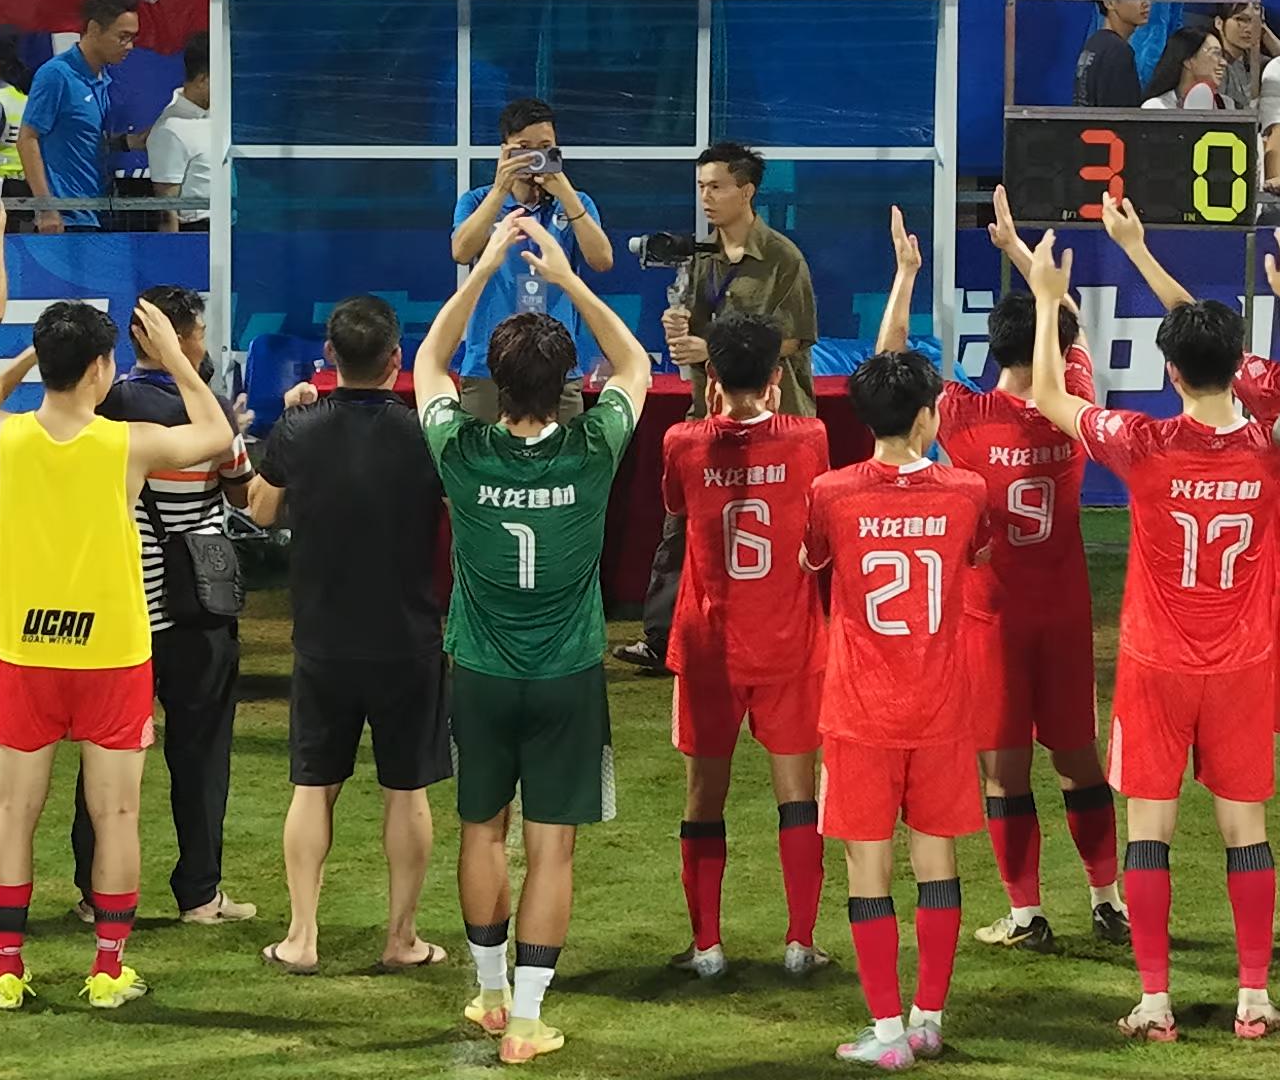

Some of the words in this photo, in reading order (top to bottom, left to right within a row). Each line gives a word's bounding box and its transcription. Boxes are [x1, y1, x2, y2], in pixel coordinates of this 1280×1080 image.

[1079, 129, 1125, 219] 3
[1193, 131, 1247, 222] 0
[723, 498, 773, 581] 6
[1006, 475, 1056, 547] 9
[1170, 511, 1254, 589] 17
[501, 522, 537, 590] 1
[862, 549, 943, 636] 21
[23, 609, 95, 637] UCAN
